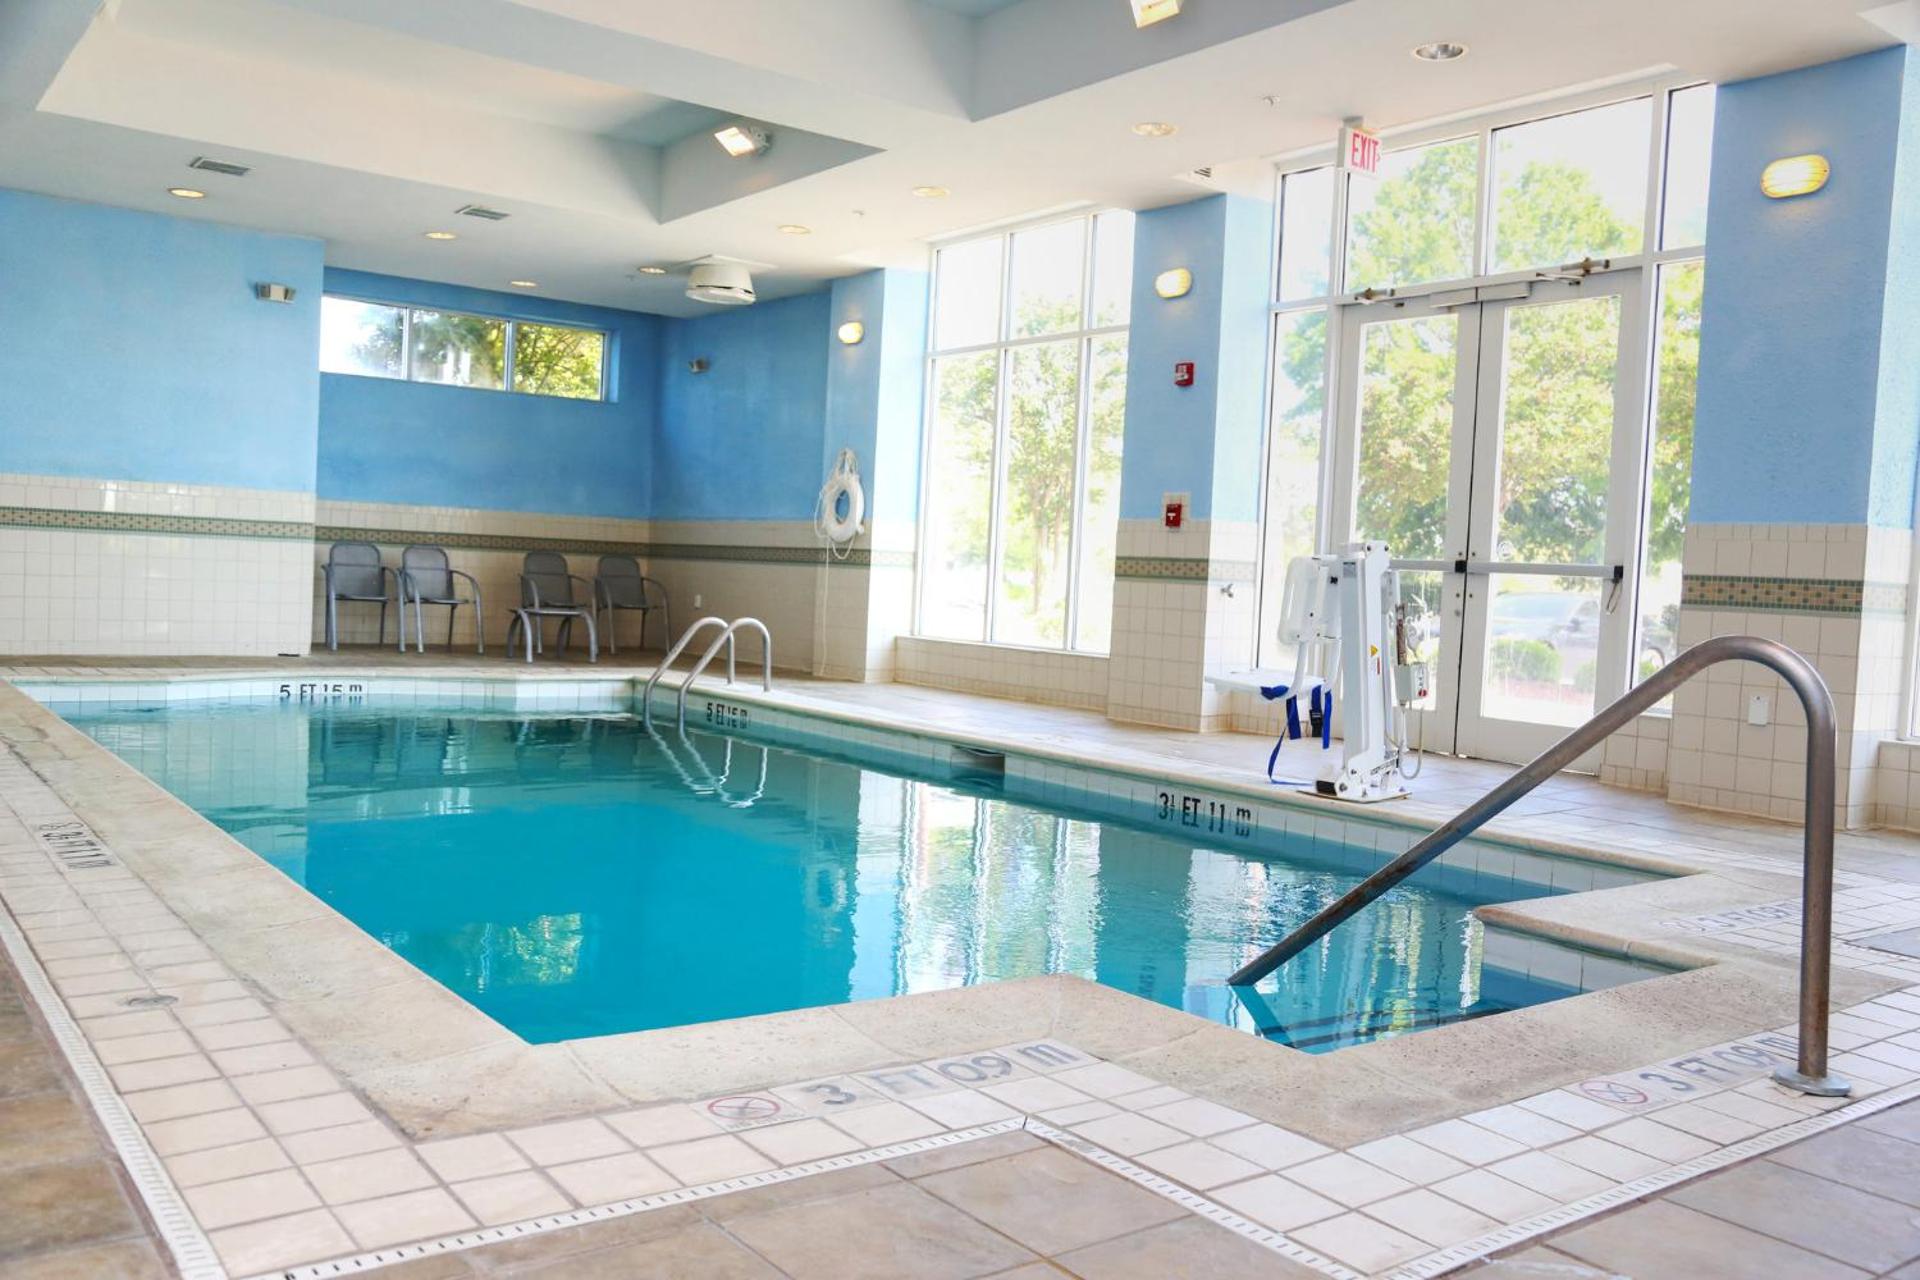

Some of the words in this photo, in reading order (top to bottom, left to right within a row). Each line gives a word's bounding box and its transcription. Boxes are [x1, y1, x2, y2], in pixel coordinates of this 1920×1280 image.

[1352, 132, 1379, 173] EXIT
[280, 685, 291, 697] 5
[300, 684, 317, 698] FT
[706, 702, 713, 717] 5
[1182, 796, 1201, 816] FT
[1236, 807, 1252, 821] m
[803, 1084, 857, 1105] 3
[868, 1068, 939, 1095] FT
[1016, 1044, 1080, 1067] m
[1640, 1072, 1698, 1092] 3
[1669, 1056, 1742, 1084] FT
